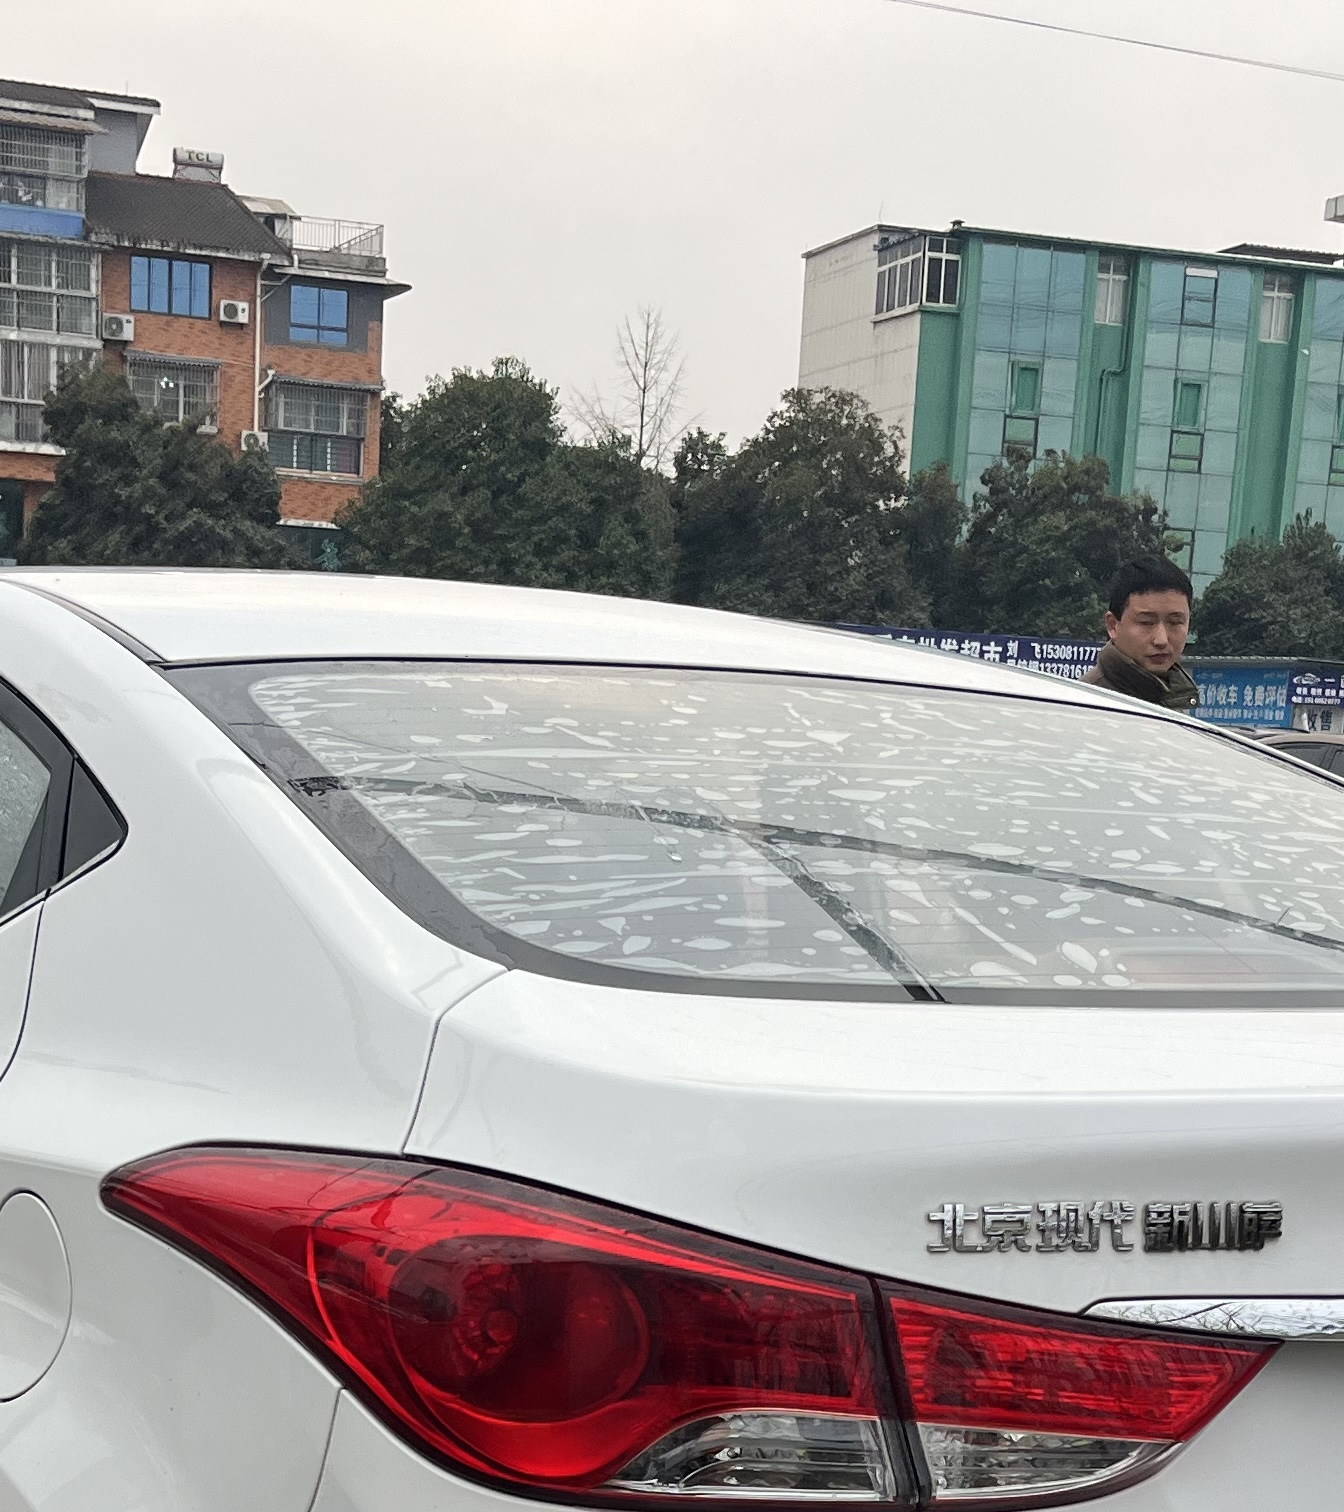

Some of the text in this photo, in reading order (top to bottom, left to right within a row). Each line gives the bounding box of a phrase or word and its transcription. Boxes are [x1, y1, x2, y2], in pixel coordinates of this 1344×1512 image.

[186, 149, 213, 164] TCL
[1243, 684, 1287, 707] 免费评估
[927, 1201, 1134, 1252] 北京现代
